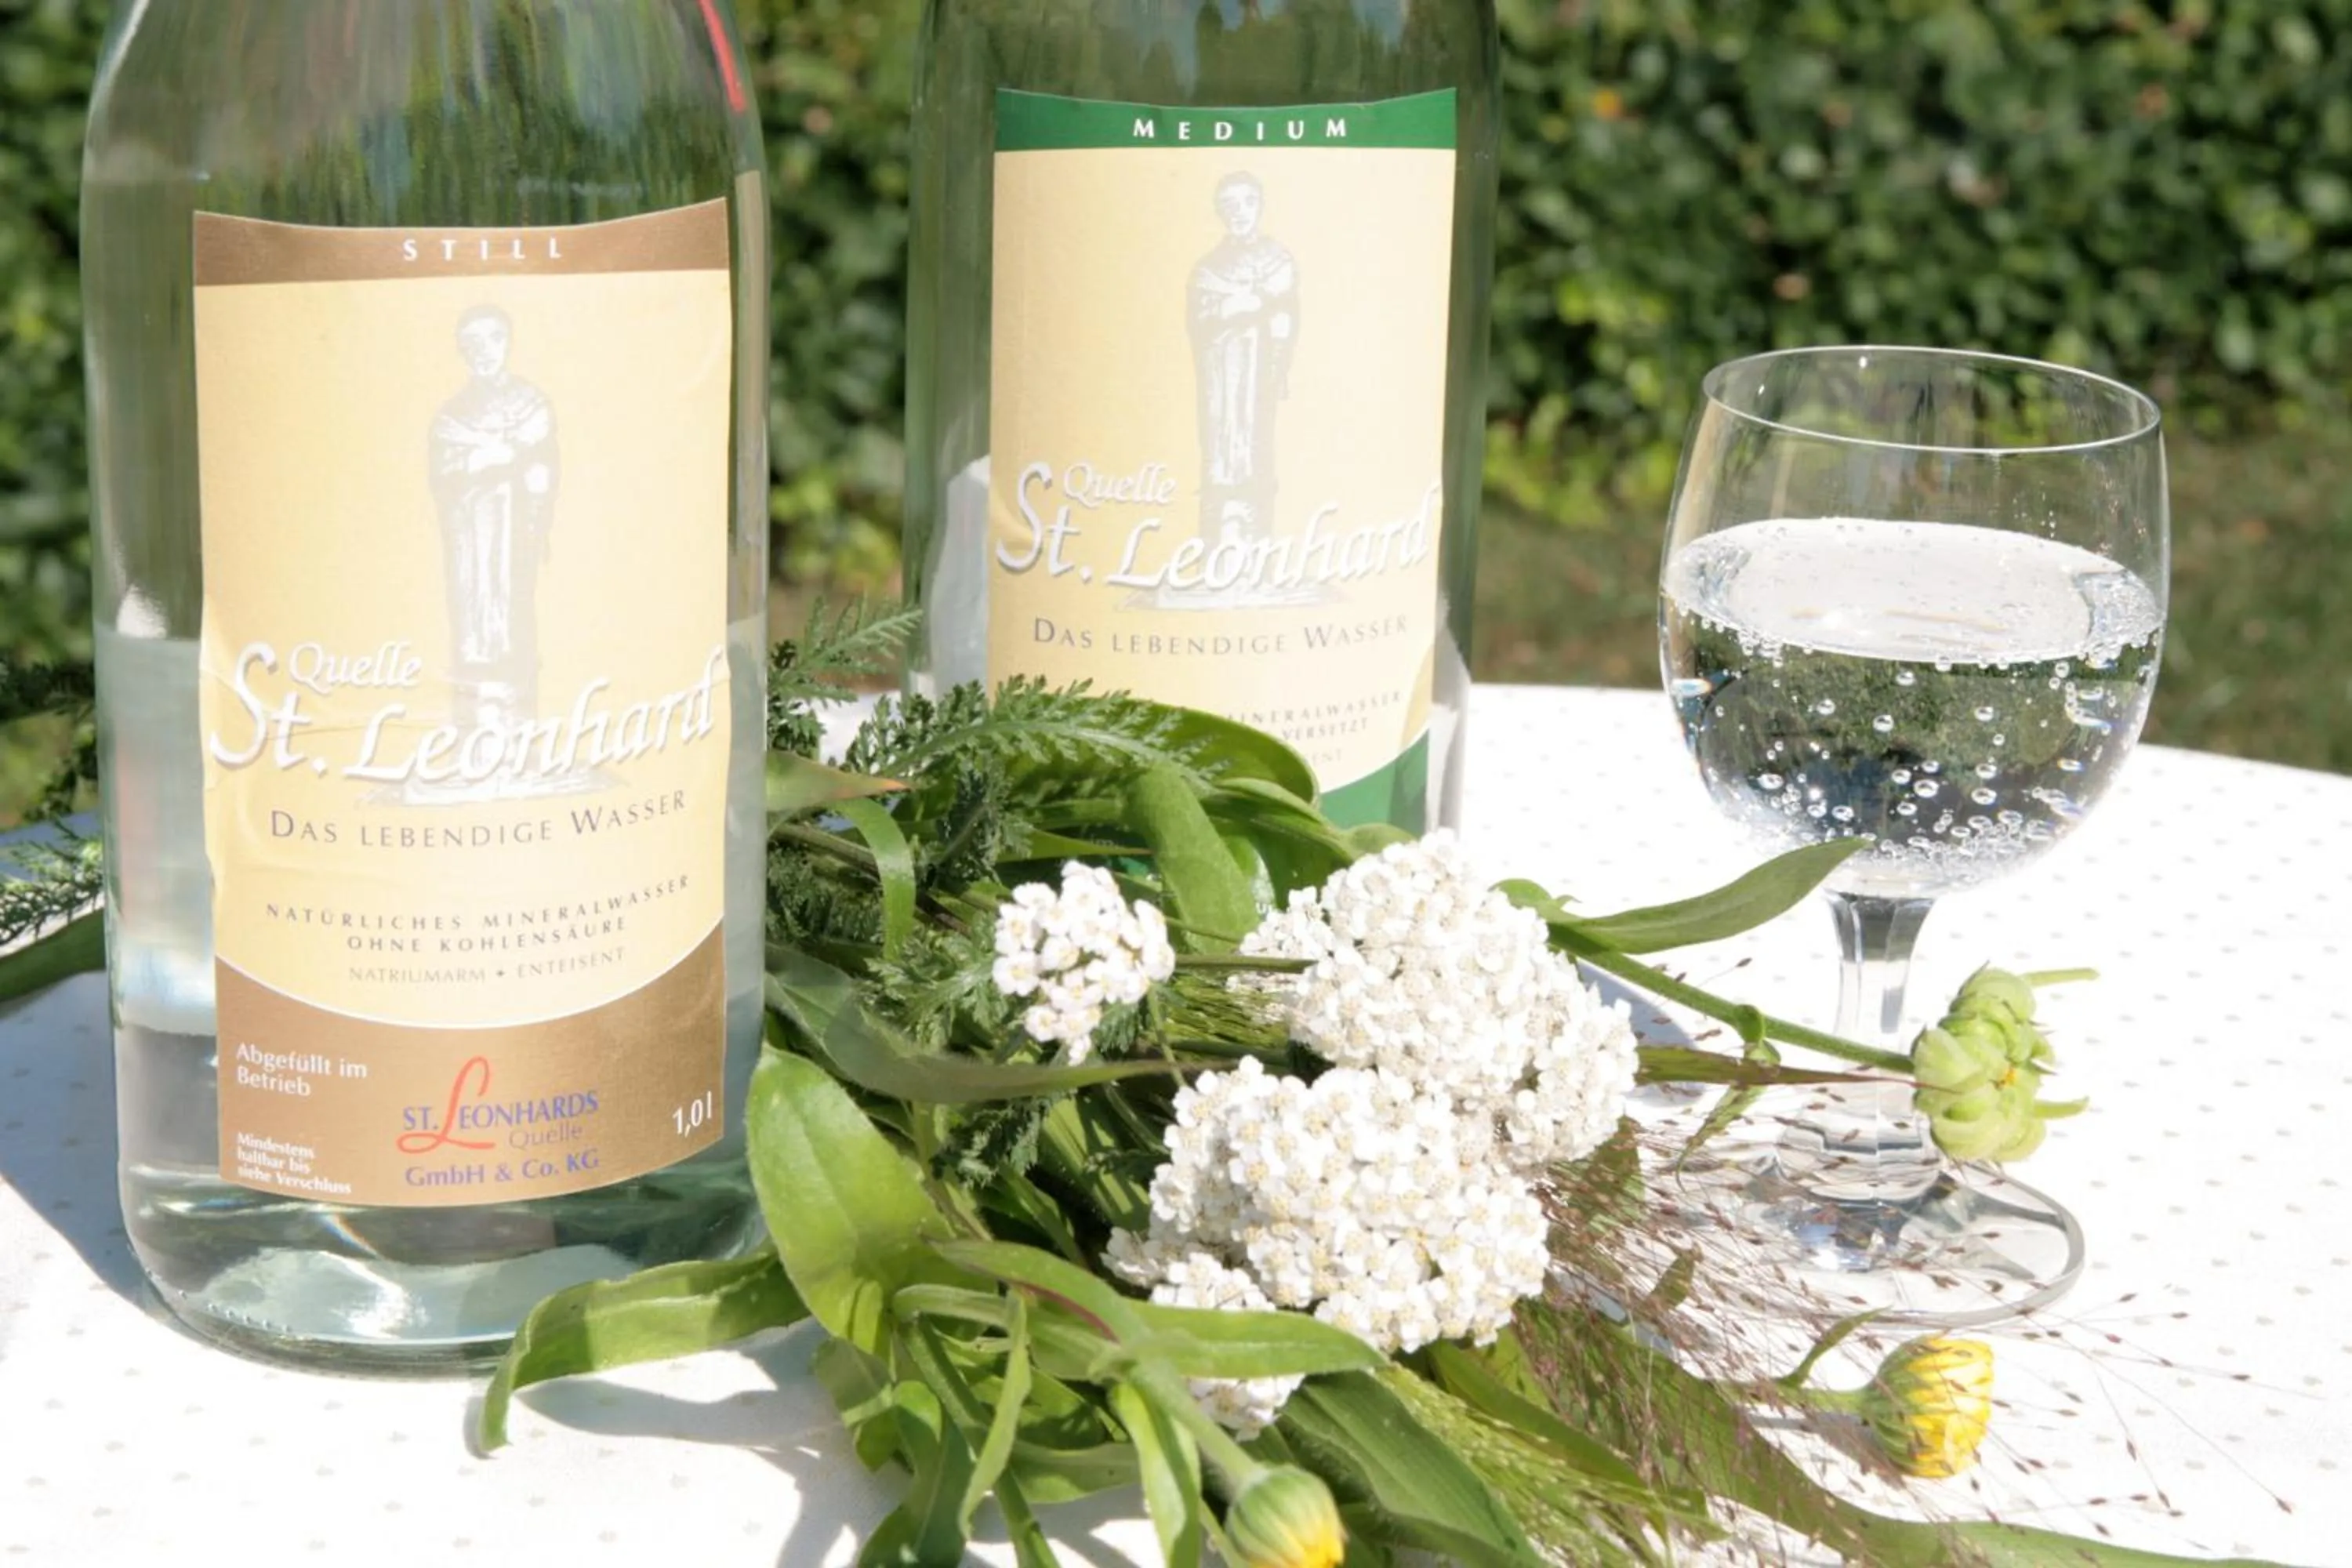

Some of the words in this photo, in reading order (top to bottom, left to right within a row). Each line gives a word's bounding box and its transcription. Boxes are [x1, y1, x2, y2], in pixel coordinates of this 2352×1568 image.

[1132, 118, 1348, 141] MEDIUM
[401, 238, 563, 262] STILL
[1062, 460, 1178, 508] Quelle
[995, 460, 1092, 584] St.
[1104, 476, 1441, 590] Leonhard
[1034, 615, 1093, 649] DAS
[1112, 633, 1287, 655] LEBENDIGE
[1303, 615, 1408, 650] WASSER
[289, 640, 422, 696] Quelle
[209, 640, 328, 779] St.
[343, 644, 724, 785] Leonhard
[1228, 691, 1401, 724] INERALWASSER
[270, 810, 337, 843] DAS
[361, 819, 553, 848] LEBENDIGE
[571, 789, 687, 834] WASSER
[266, 903, 461, 930] NATÜRLICHES
[481, 874, 688, 928] MINERALWASSER
[347, 935, 421, 952] OHNE
[349, 967, 485, 984] NATRIUMARM
[518, 946, 624, 978] ENTEISENT
[236, 1041, 332, 1075] Abgefüllt
[339, 1058, 368, 1079] im
[237, 1065, 311, 1097] Betrieb
[509, 1121, 583, 1151] Quelle
[405, 1163, 485, 1187] GmbH
[495, 1162, 514, 1181] &
[522, 1158, 560, 1179] Co.
[568, 1147, 599, 1173] KG
